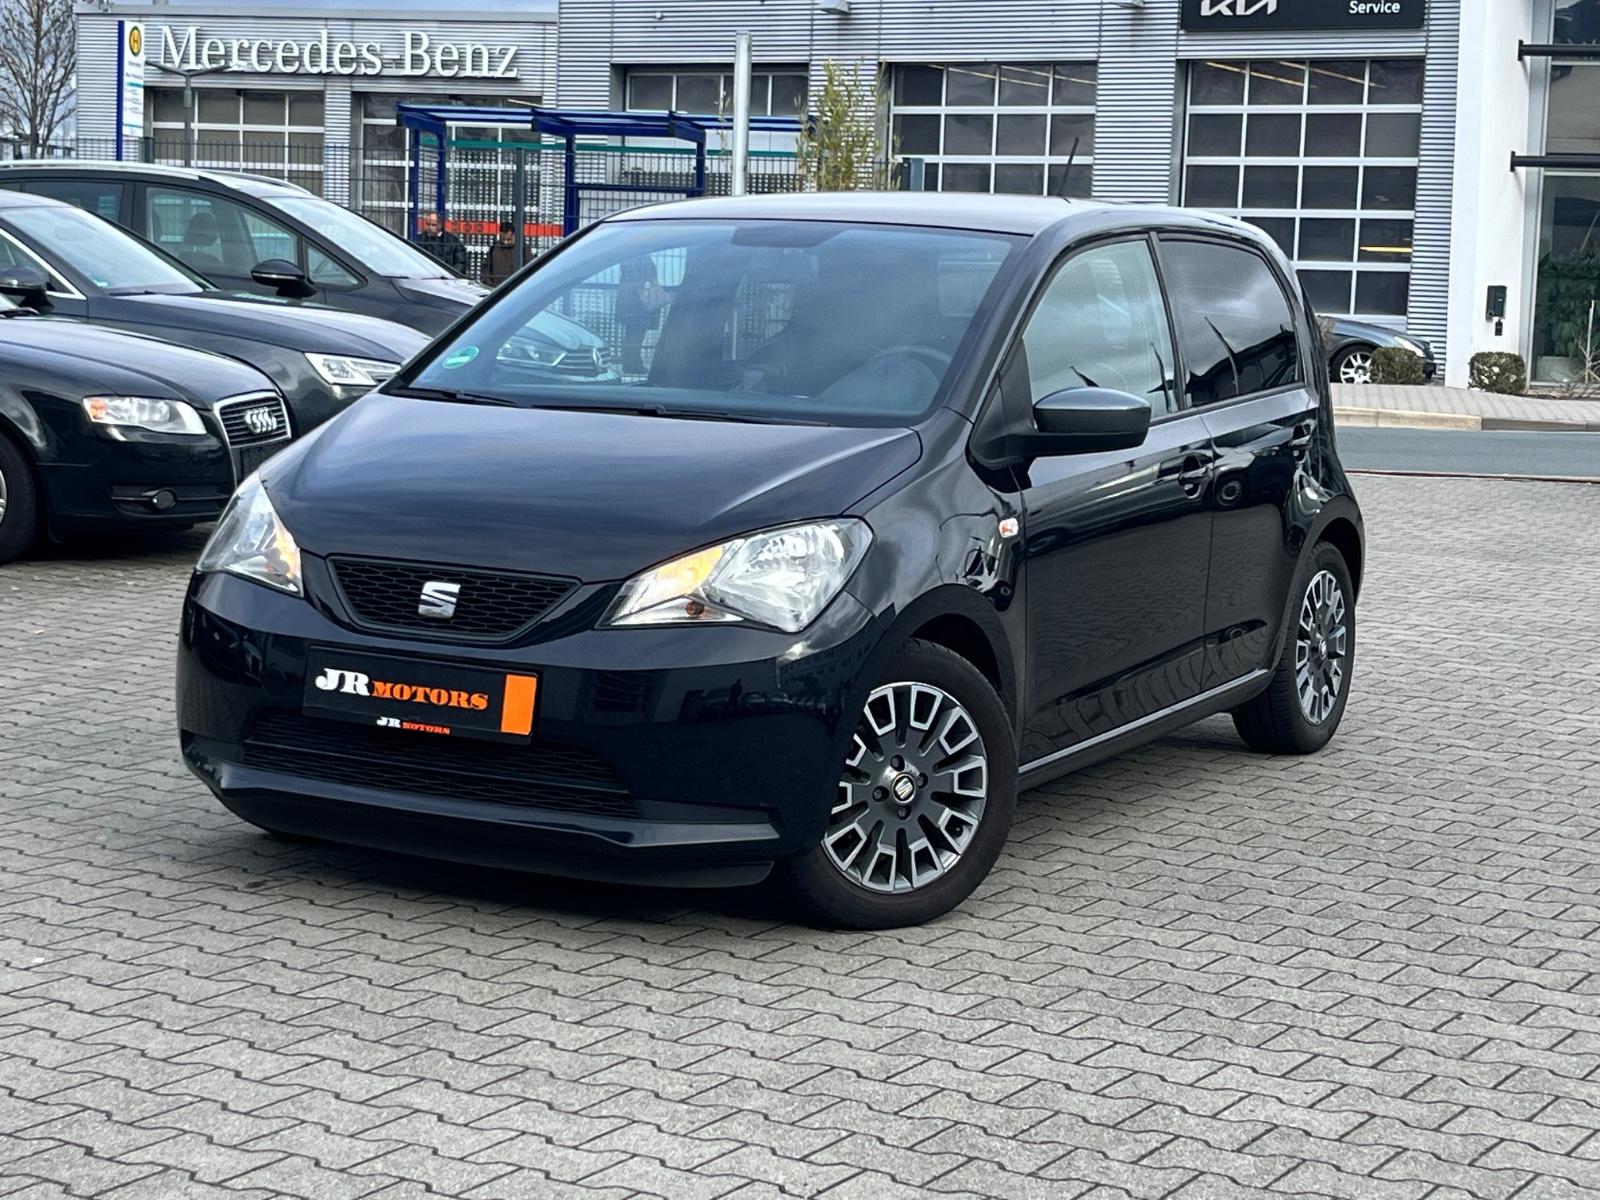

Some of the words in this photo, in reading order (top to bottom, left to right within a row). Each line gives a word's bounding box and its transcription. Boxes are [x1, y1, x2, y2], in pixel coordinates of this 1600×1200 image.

[1349, 0, 1400, 14] Service
[161, 25, 520, 78] Mercedes-Benz
[315, 668, 370, 697] JR
[372, 680, 489, 710] MOTORS
[376, 716, 401, 728] JR
[402, 721, 450, 734] MOTORS
